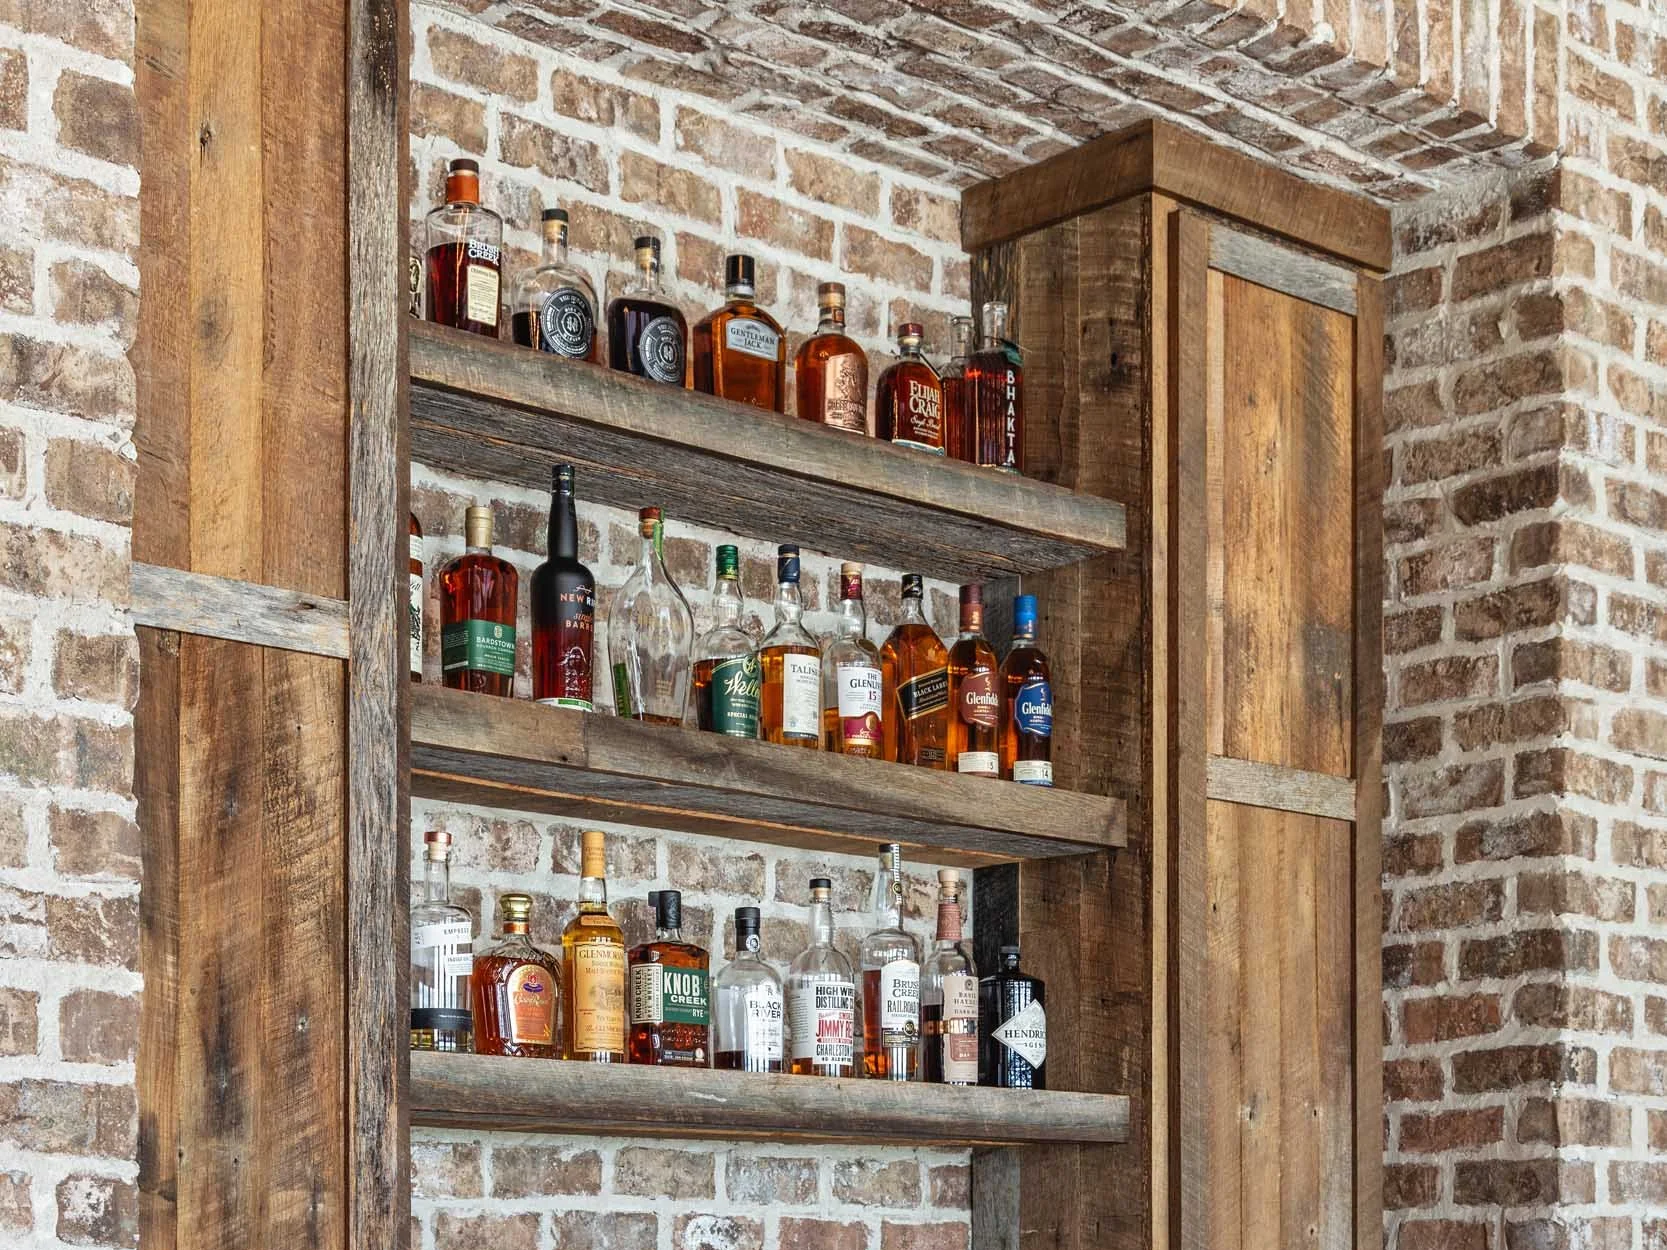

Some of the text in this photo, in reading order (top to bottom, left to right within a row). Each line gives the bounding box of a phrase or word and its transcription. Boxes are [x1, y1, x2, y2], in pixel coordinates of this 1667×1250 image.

[468, 239, 500, 257] BRUSH
[468, 248, 500, 266] CREEK
[730, 327, 775, 345] GENTLEMAN
[744, 338, 763, 349] JACK
[909, 379, 940, 404] ELIJAH
[909, 396, 940, 420] CRAIG
[1006, 369, 1016, 464] BHAKTA
[560, 593, 584, 603] NEW
[790, 663, 818, 676] TALIS
[867, 672, 878, 681] THE
[868, 690, 877, 701] 15
[912, 686, 932, 698] BLACK
[664, 971, 700, 997] KNOB
[815, 986, 839, 996] HIGH
[670, 995, 707, 1006] CREEK
[692, 1008, 704, 1018] RYE
[815, 1019, 845, 1037] JIMMY
